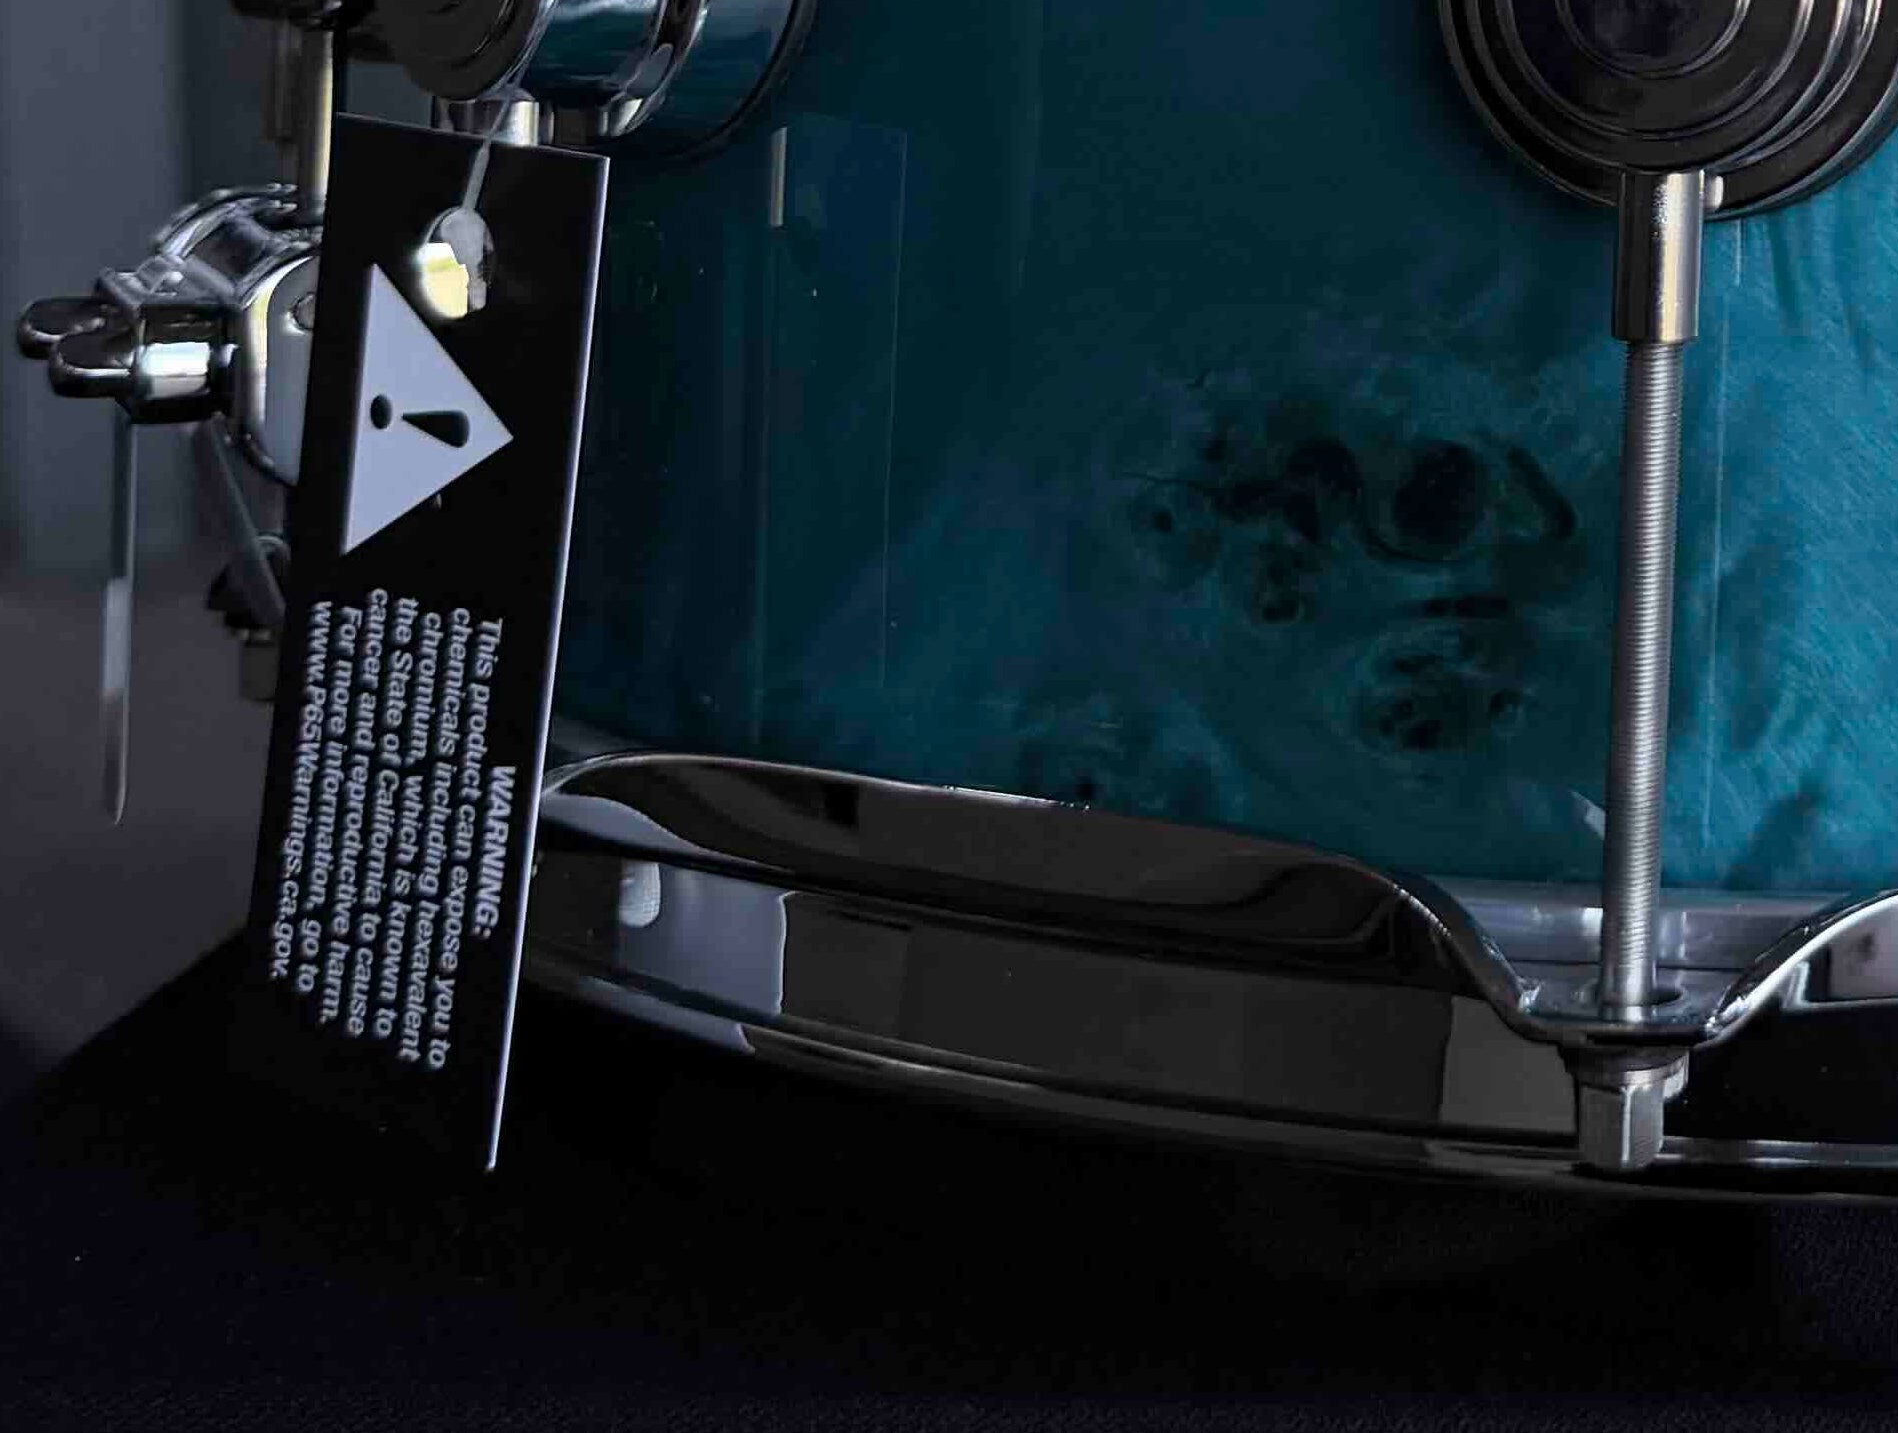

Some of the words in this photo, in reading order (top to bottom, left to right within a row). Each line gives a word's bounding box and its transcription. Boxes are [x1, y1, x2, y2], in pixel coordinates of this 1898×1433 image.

[338, 606, 362, 654] For
[362, 588, 387, 688] cancer
[394, 597, 418, 643] the
[474, 618, 502, 677] This
[328, 659, 352, 734] more
[385, 650, 412, 726] State
[437, 607, 472, 754] chemicals
[354, 692, 375, 749] and
[381, 733, 401, 764] of
[461, 682, 489, 799] product
[332, 754, 369, 934] reproductive
[363, 769, 399, 905] California
[397, 775, 423, 862] which
[417, 761, 457, 895] including
[454, 804, 475, 859] can
[474, 766, 515, 939] WARNING:
[393, 868, 415, 894] is
[440, 865, 468, 970] expose
[300, 918, 321, 956] go
[359, 912, 381, 941] to
[380, 900, 411, 1000] known
[297, 963, 318, 991] to
[320, 940, 350, 1022] harm.
[347, 947, 373, 1035] cause
[399, 900, 440, 1060] hexavalent
[433, 975, 454, 1030] you
[375, 1007, 397, 1036] to
[428, 1038, 450, 1068] to
